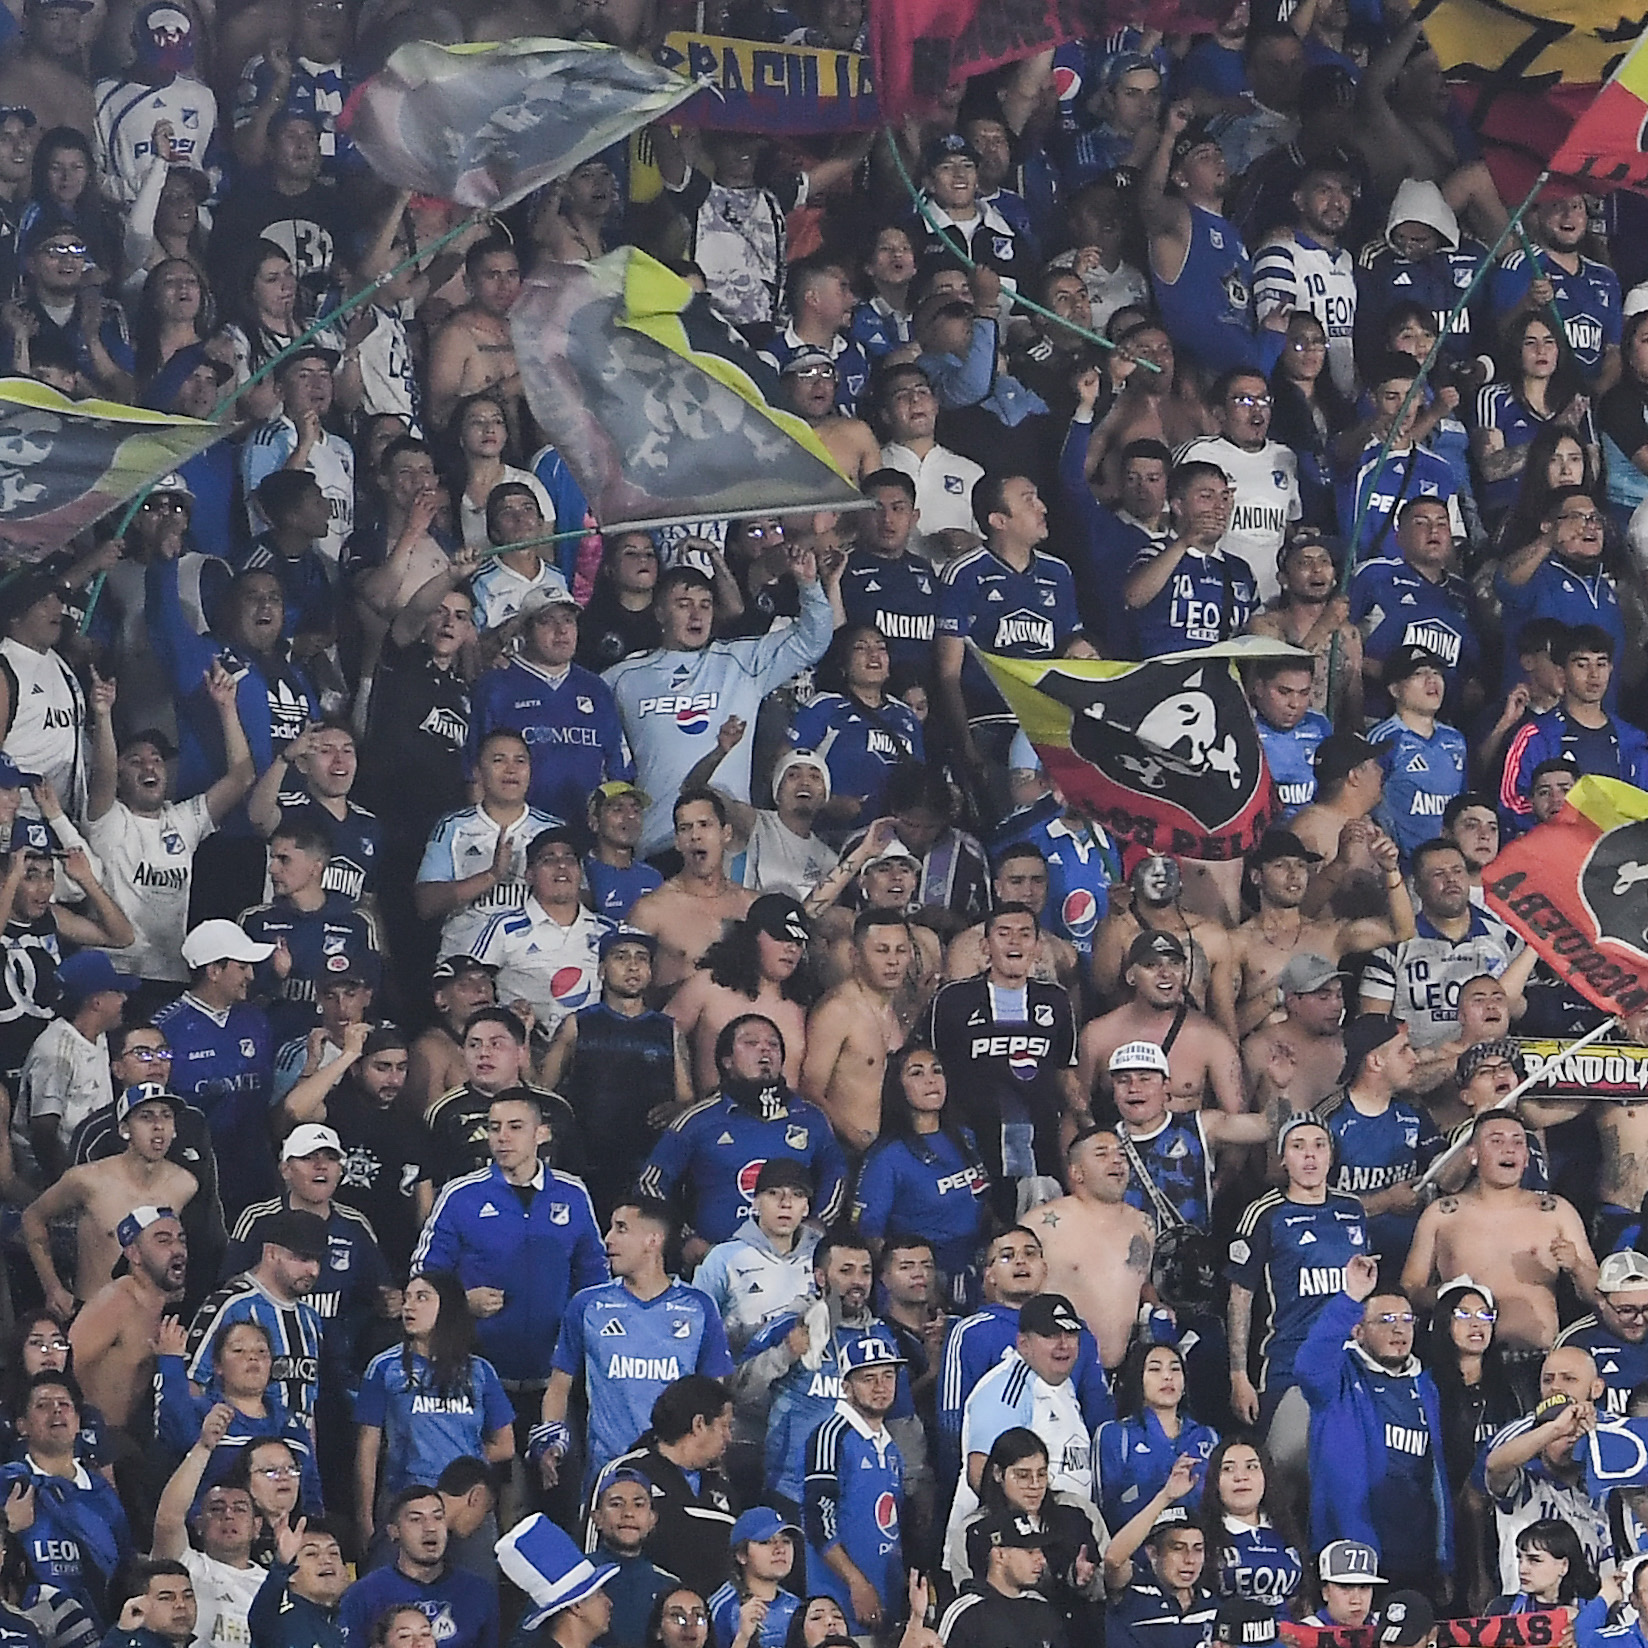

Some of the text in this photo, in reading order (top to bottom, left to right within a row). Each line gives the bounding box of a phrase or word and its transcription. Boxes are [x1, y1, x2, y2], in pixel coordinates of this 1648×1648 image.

[1304, 274, 1326, 298] 10
[876, 611, 936, 642] ANDINA
[994, 620, 1053, 648] ANDINA
[639, 692, 718, 716] PEPSI
[1407, 962, 1428, 983] 10
[971, 1037, 1049, 1059] PEPSI
[610, 1355, 679, 1381] ANDINA
[1345, 1550, 1371, 1570] 77
